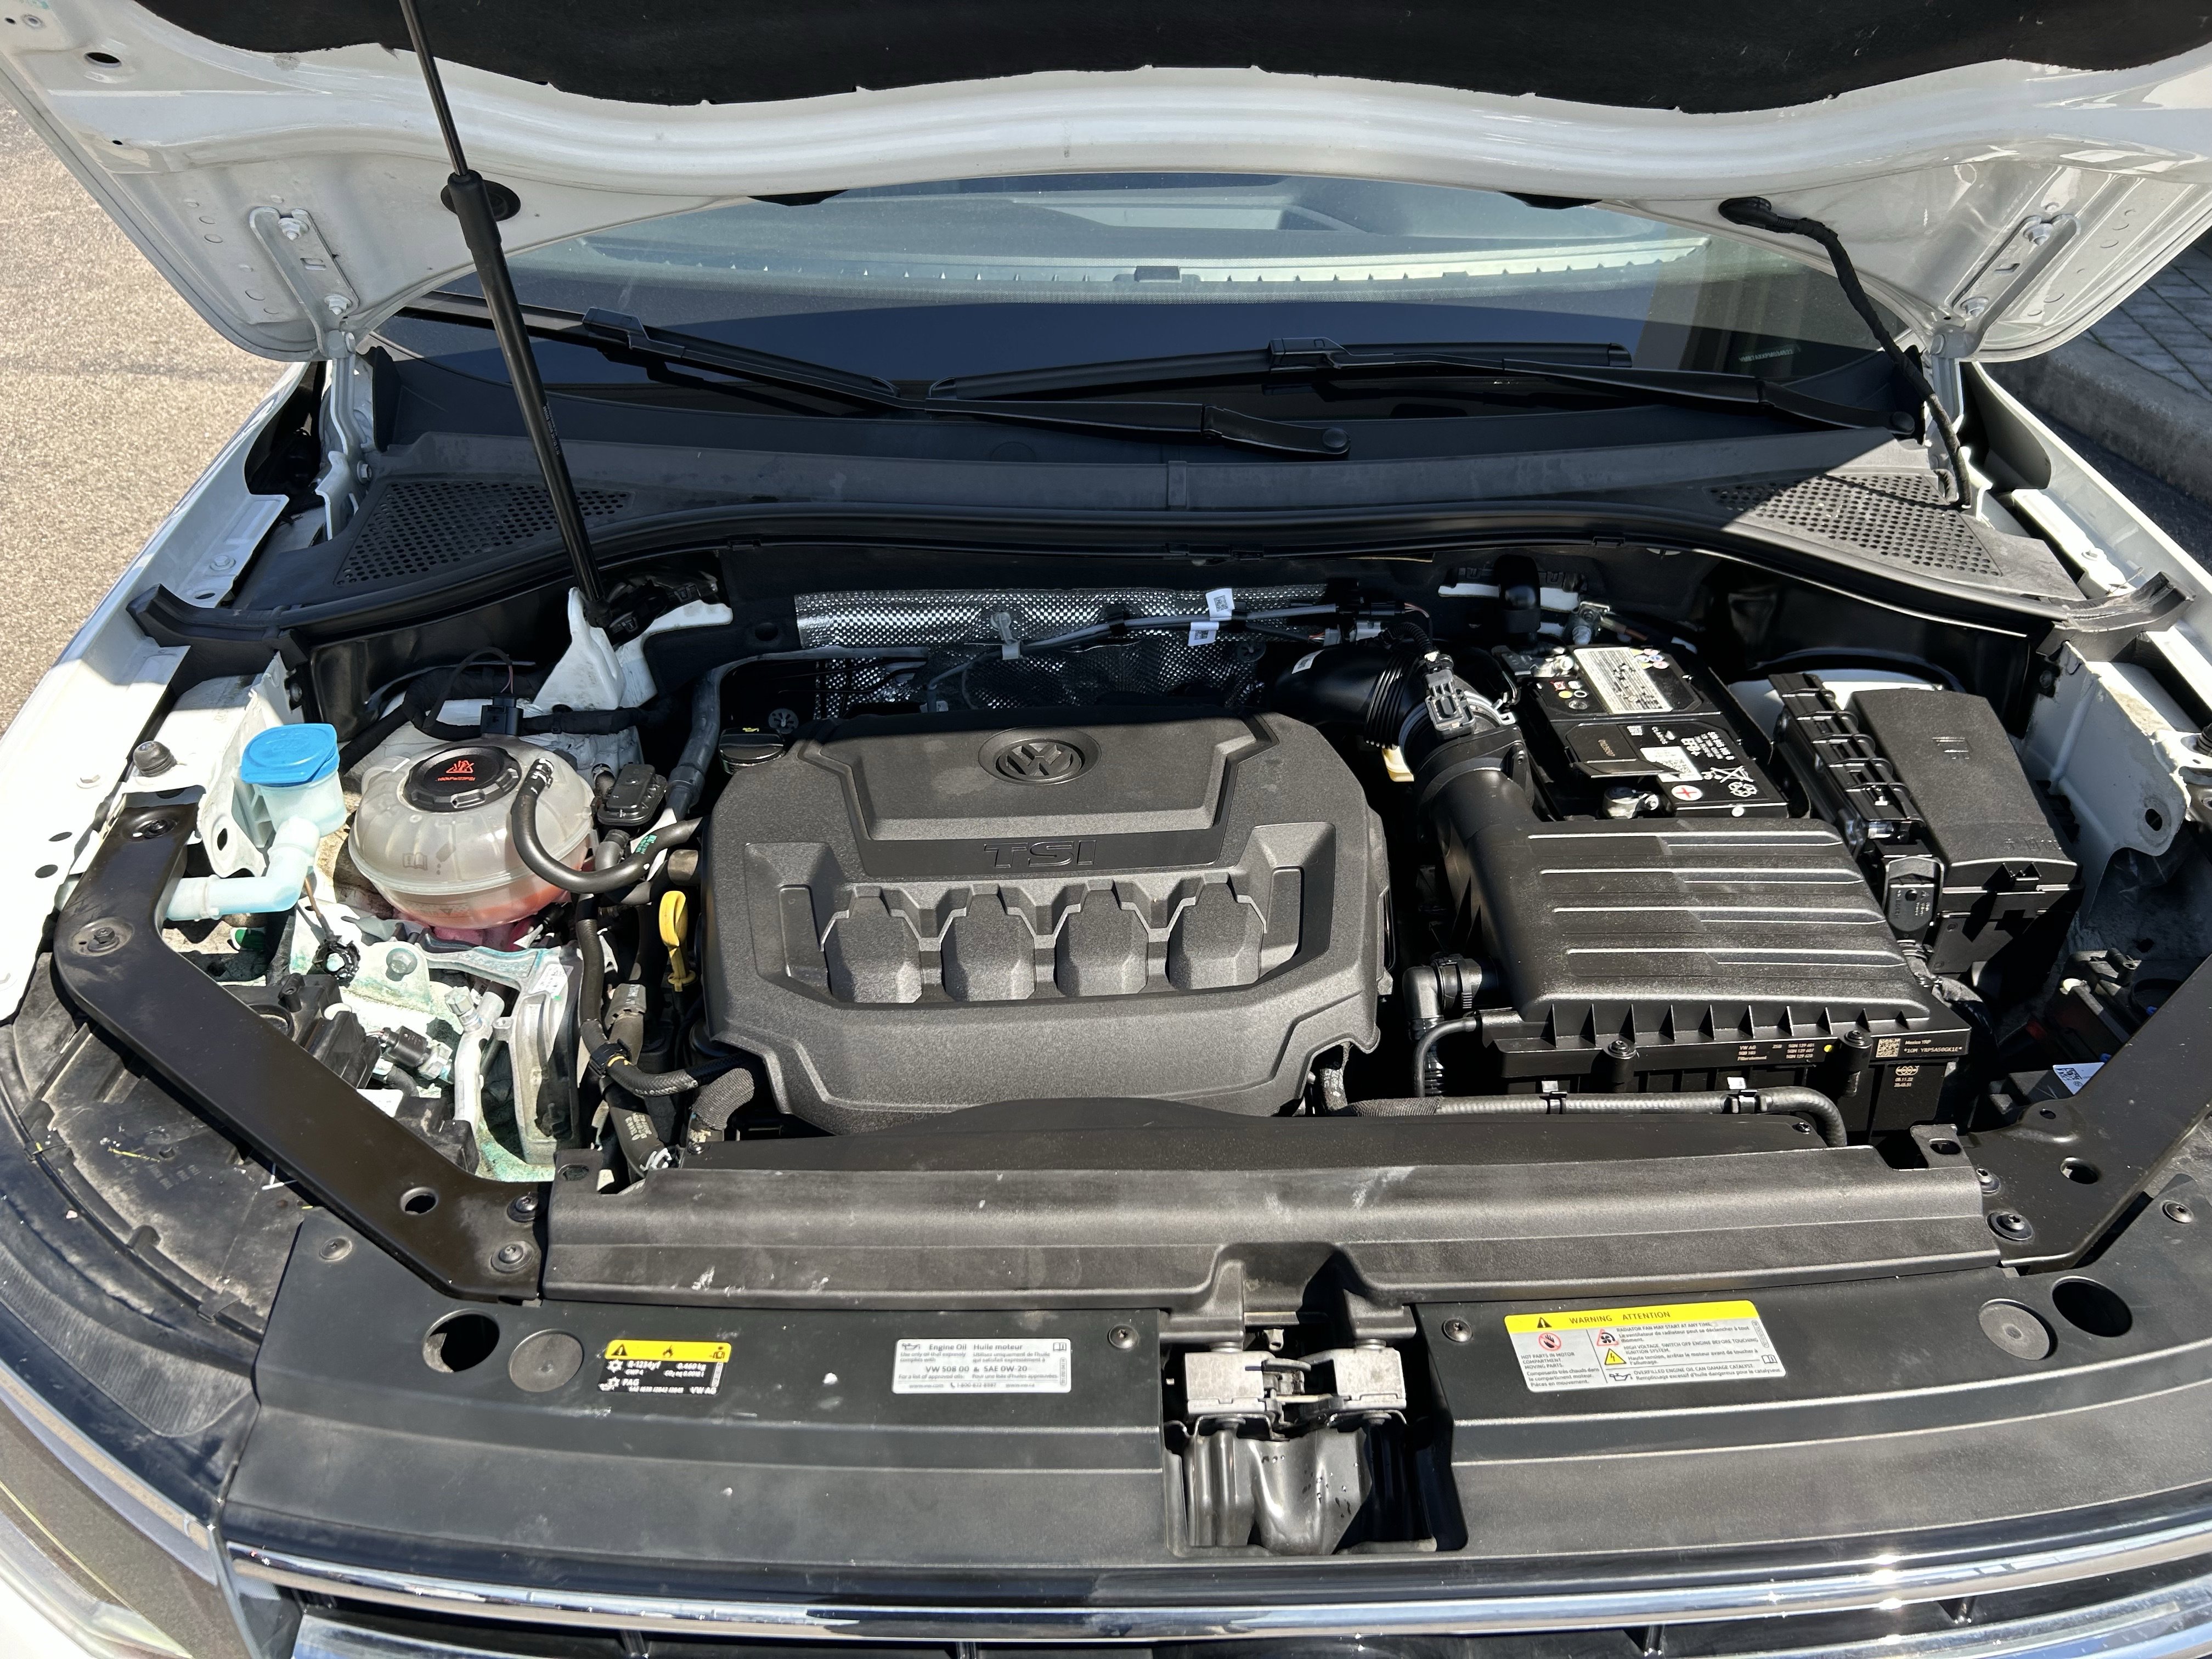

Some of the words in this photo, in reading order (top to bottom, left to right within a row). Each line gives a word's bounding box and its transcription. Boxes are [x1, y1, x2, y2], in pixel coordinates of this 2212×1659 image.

[984, 840, 1096, 868] TSI
[1569, 1315, 1612, 1324] WARNING
[1623, 1311, 1671, 1321] ATTENTION
[627, 1360, 662, 1370] R-1234yf
[697, 1363, 707, 1371] kg
